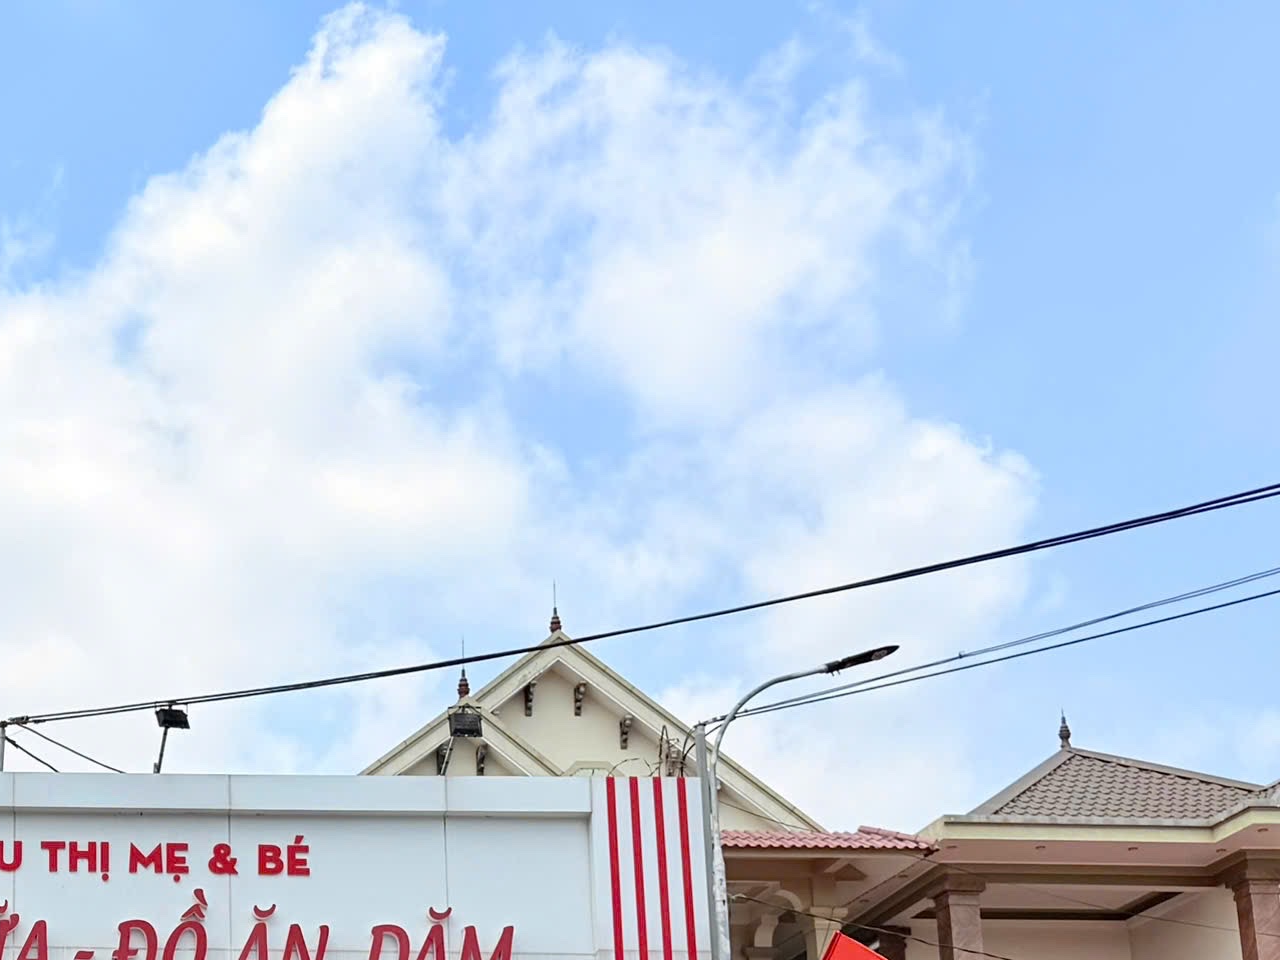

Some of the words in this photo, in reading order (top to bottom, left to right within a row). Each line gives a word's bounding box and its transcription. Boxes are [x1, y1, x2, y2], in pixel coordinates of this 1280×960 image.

[40, 840, 110, 882] THỊ
[129, 842, 189, 883] MẸ
[208, 843, 238, 875] &
[258, 835, 310, 877] BÉ
